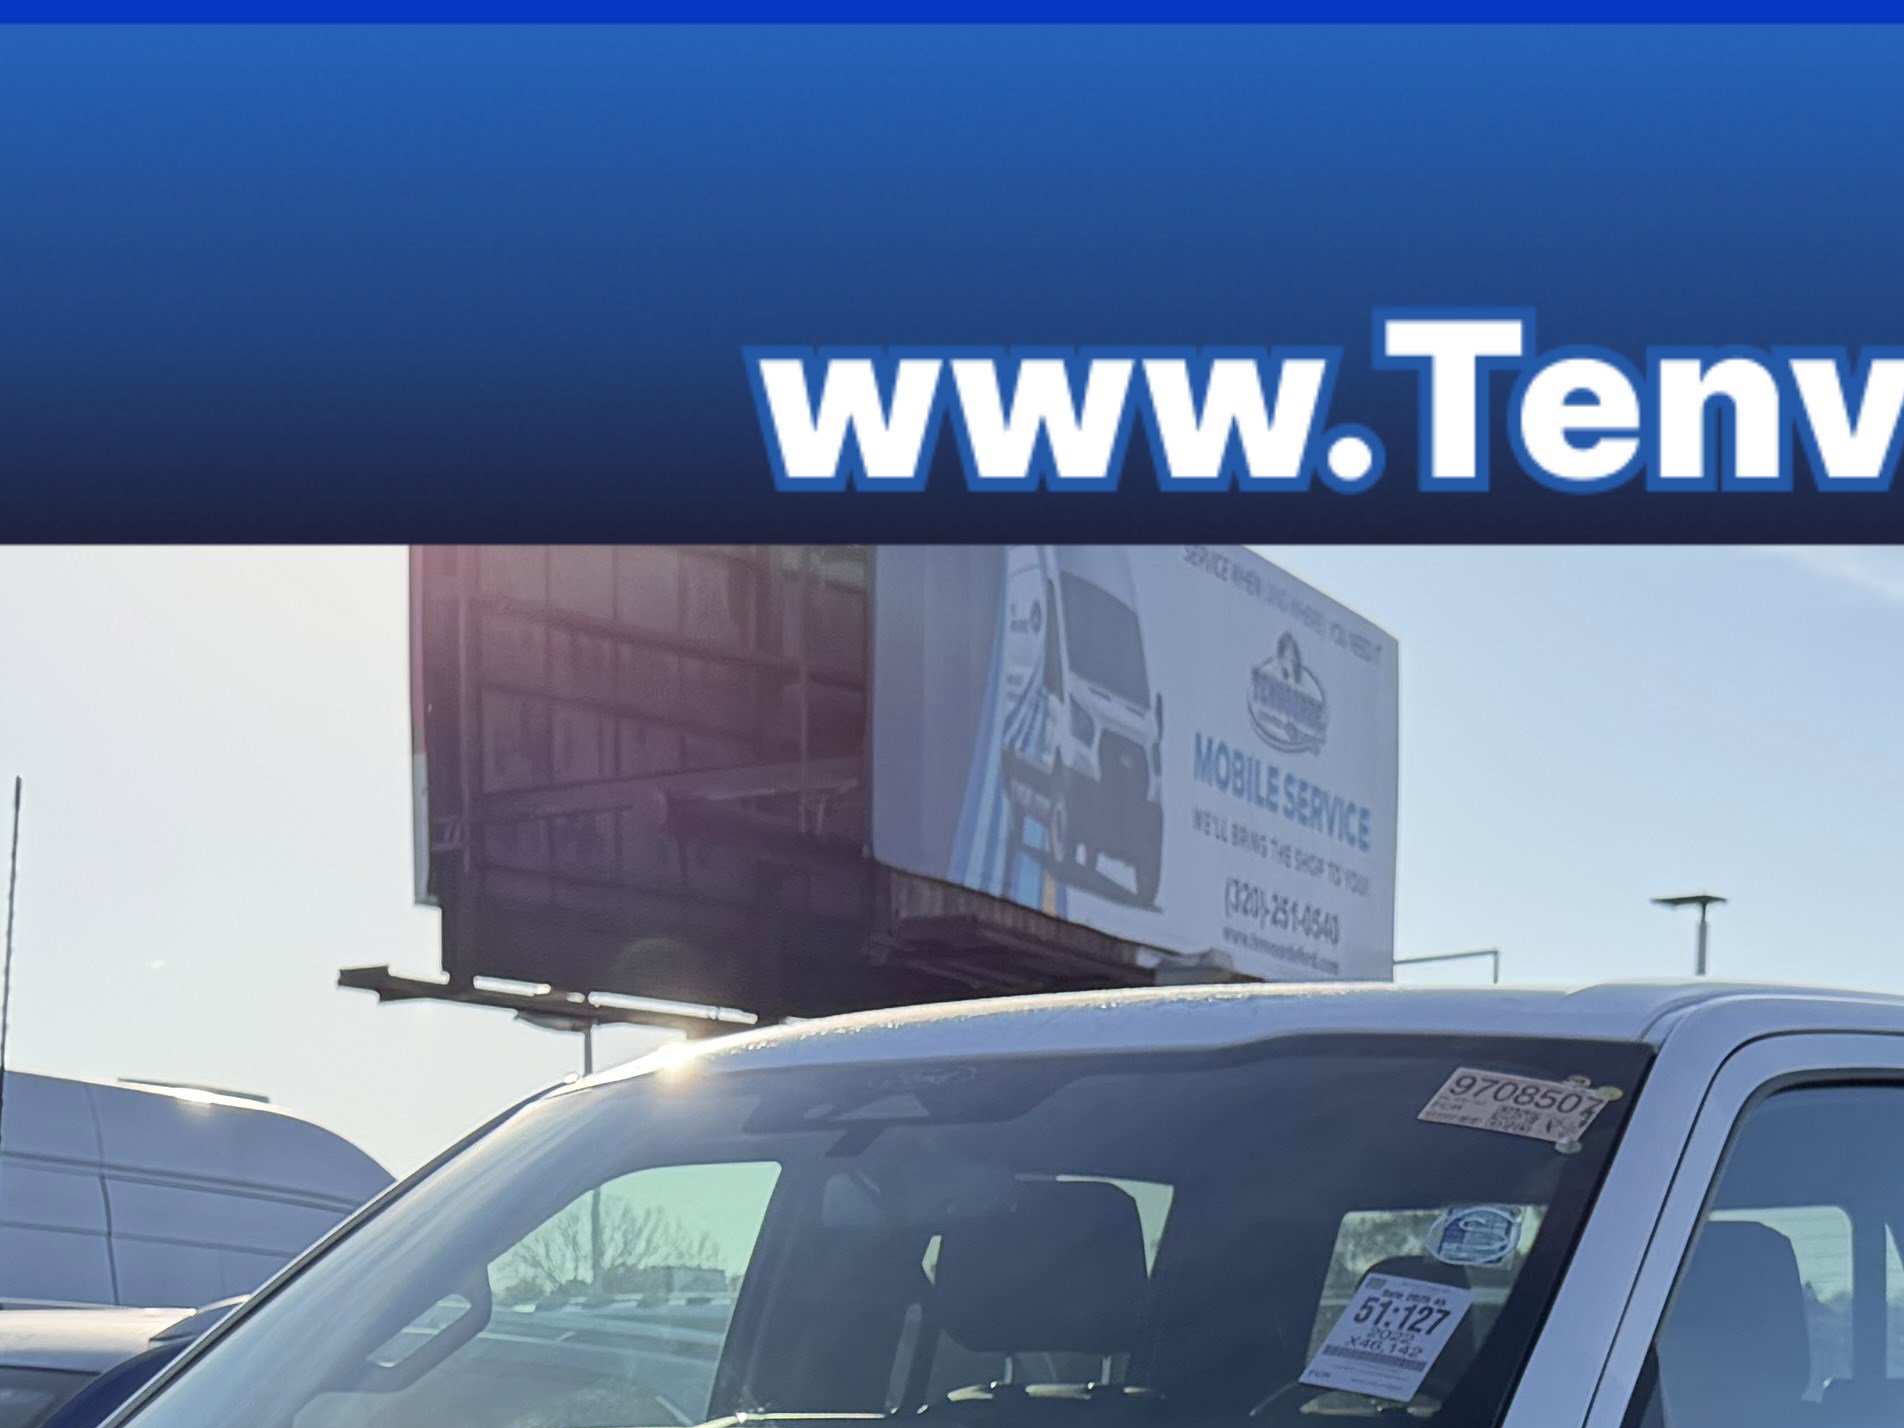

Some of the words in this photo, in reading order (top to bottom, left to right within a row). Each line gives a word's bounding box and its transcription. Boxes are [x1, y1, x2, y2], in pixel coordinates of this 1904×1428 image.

[1194, 732, 1279, 813] MOBILE
[1284, 772, 1371, 854] SERVICE
[1353, 1297, 1451, 1336] 51:127
